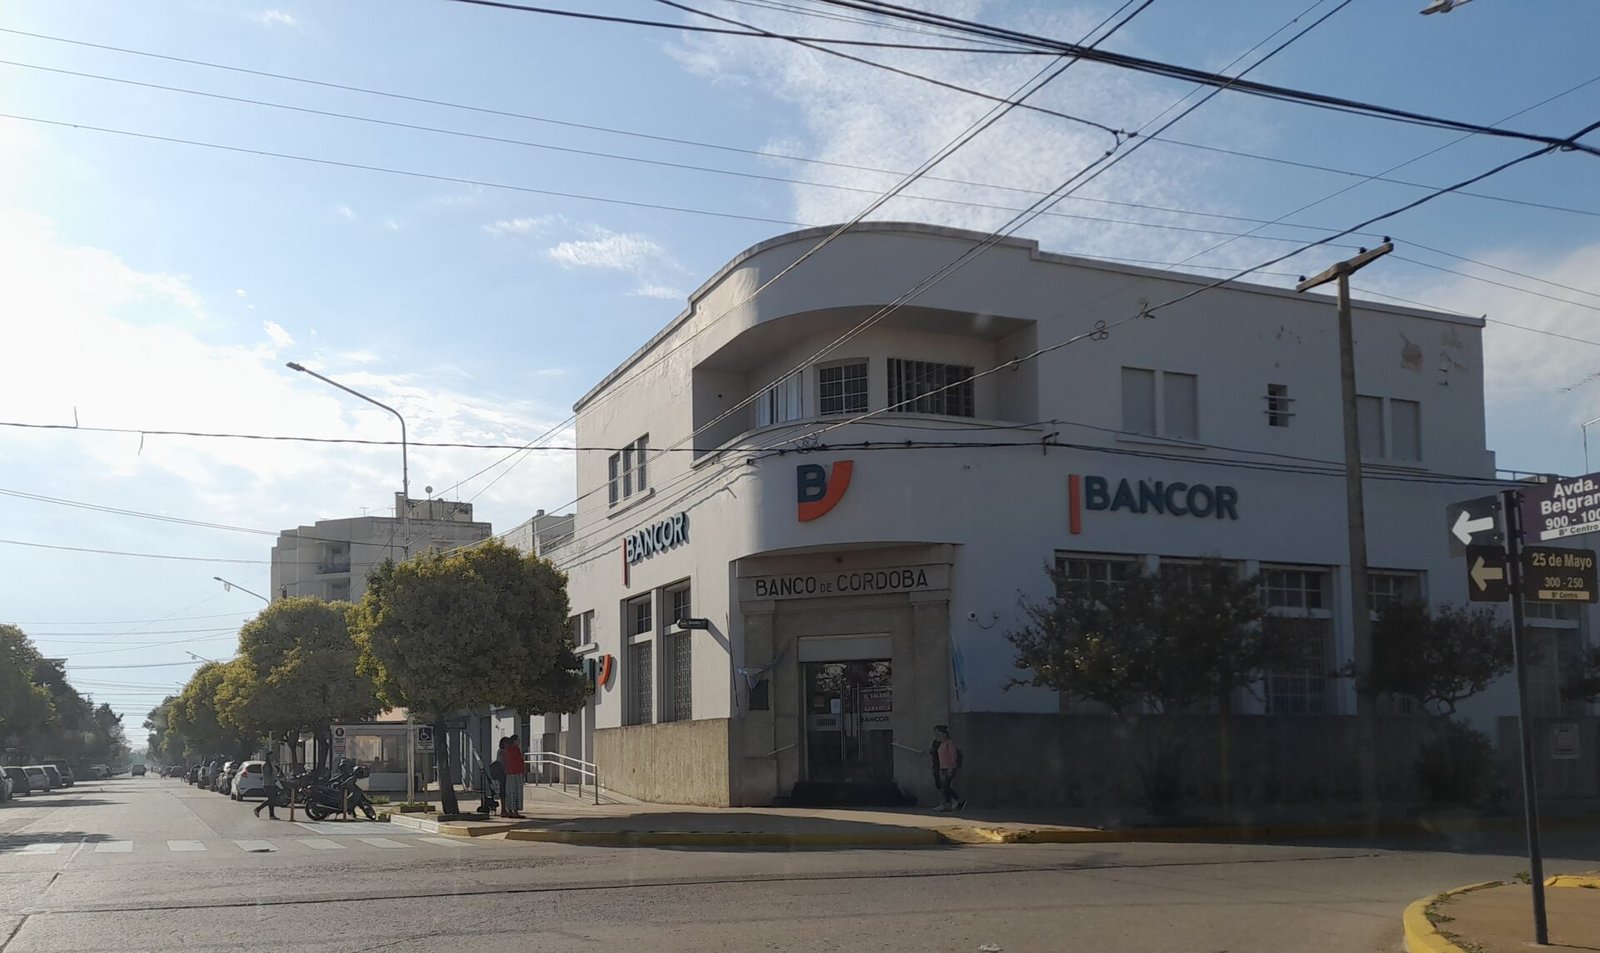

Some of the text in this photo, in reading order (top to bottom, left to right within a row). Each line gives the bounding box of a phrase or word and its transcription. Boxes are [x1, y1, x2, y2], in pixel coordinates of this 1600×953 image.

[1085, 475, 1239, 520] BANCOR
[1553, 478, 1599, 499] Avda.
[1545, 515, 1569, 530] 900
[1570, 524, 1599, 535] Centro
[626, 512, 686, 563] BANCOR
[1532, 552, 1592, 571] 25 de Mayo
[755, 569, 928, 597] BANCO DE CORDOBA
[1544, 576, 1561, 588] 300
[1567, 577, 1584, 589] 250
